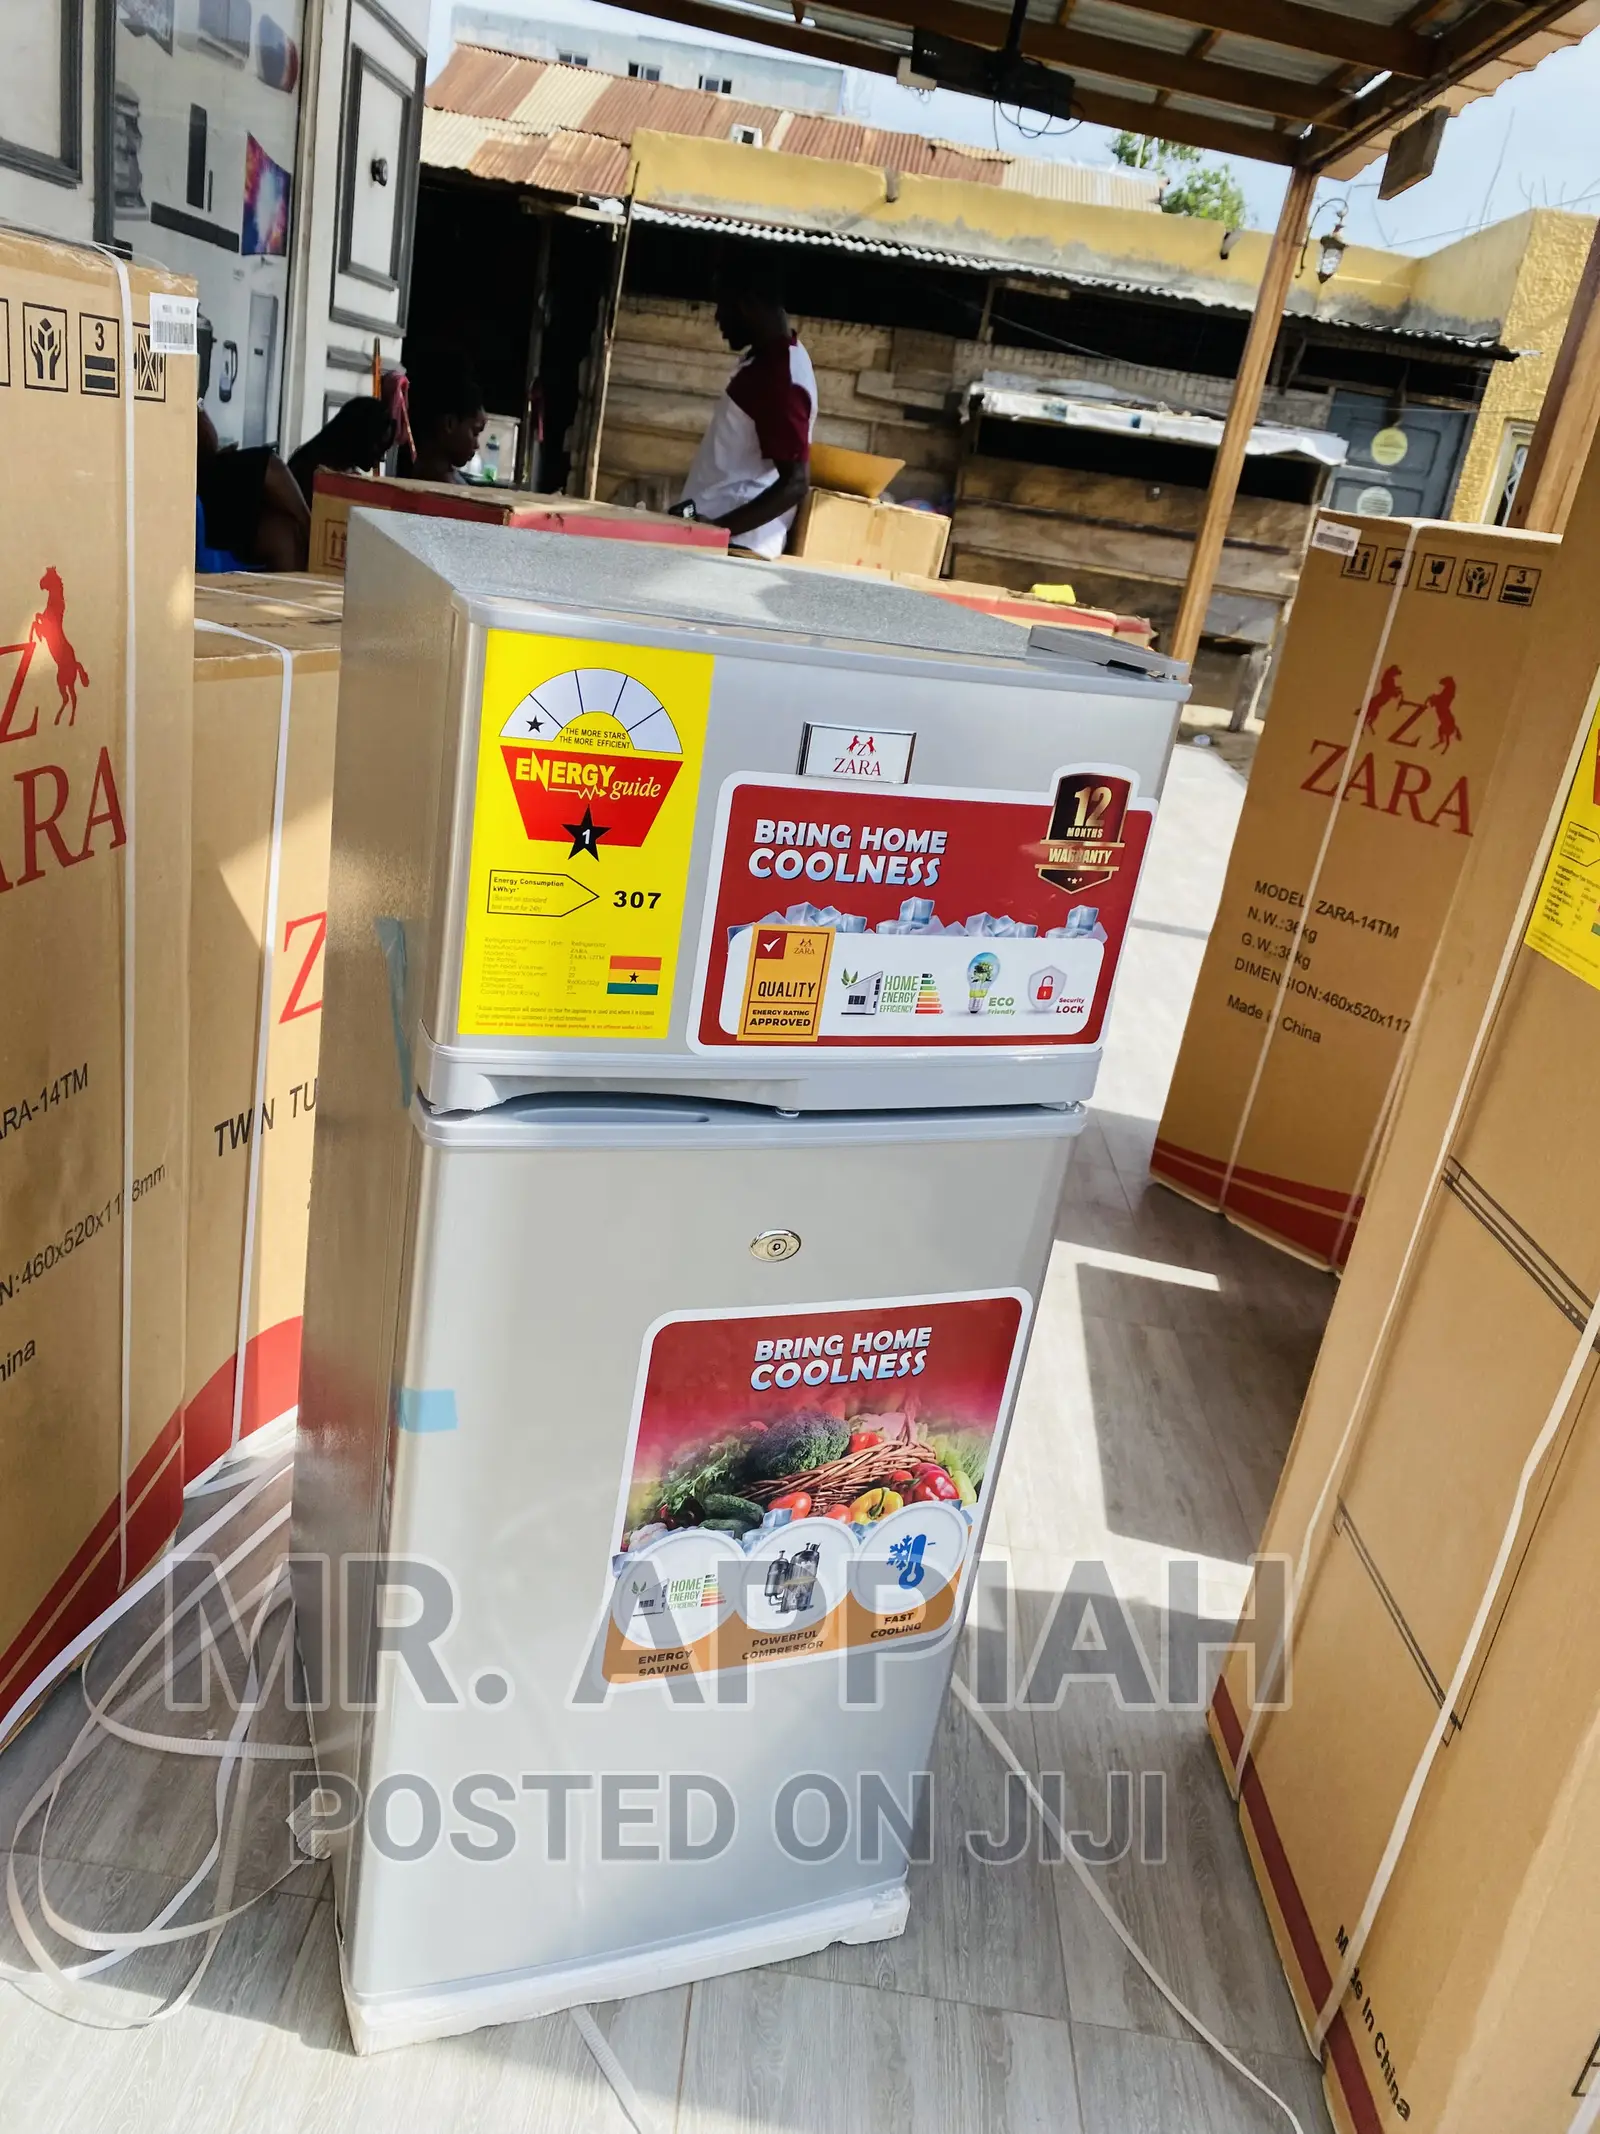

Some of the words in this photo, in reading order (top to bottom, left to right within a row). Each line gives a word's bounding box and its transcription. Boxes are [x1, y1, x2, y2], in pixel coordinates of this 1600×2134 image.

[94, 322, 105, 352] 3
[1516, 570, 1527, 584] 3
[1387, 699, 1428, 748] Z
[559, 735, 573, 744] THE
[574, 737, 594, 746] MORE
[597, 739, 631, 749] EFFICIENT
[566, 727, 579, 736] THE
[581, 729, 602, 738] MORE
[604, 731, 626, 740] STARS
[515, 750, 616, 792] ENERGY
[609, 776, 662, 801] guide
[832, 757, 882, 777] ZARA
[1300, 739, 1473, 838] ZARA
[1073, 786, 1113, 828] 12
[0, 746, 127, 893] RA
[582, 829, 591, 845] 1
[754, 818, 851, 849] BRING
[859, 826, 948, 854] HOME
[1066, 827, 1104, 839] MONTHS
[1048, 848, 1113, 865] WARRANTY
[748, 847, 941, 887] COOLNESS
[493, 876, 517, 886] Energy
[520, 878, 565, 888] Consumption
[612, 890, 662, 909] 307
[1315, 900, 1400, 940] ZARA-14TM
[757, 980, 817, 998] QUALITY
[884, 974, 919, 991] HOME
[881, 992, 917, 1004] ENERGY
[988, 997, 1015, 1007] ECO
[1059, 997, 1085, 1005] Security
[879, 1004, 913, 1013] EFFICIENCY
[987, 1008, 1016, 1016] Friendly
[1056, 1005, 1084, 1014] LOCK
[749, 1018, 811, 1027] APPROVED
[1227, 994, 1263, 1019] Made
[1282, 1016, 1322, 1044] China
[0, 1062, 88, 1141] RA-14TM
[213, 1097, 275, 1158] TWN
[754, 1334, 844, 1362] BRING
[850, 1326, 933, 1355] HOME
[750, 1349, 928, 1391] COOLNESS
[670, 1577, 703, 1593] HOME
[669, 1591, 701, 1603] ENERGY
[884, 1612, 914, 1625] FAST
[752, 1630, 818, 1648] POWERFUL
[870, 1622, 922, 1639] COOLING
[638, 1650, 693, 1665] ENERGY
[741, 1641, 824, 1660] COMPRESSOR
[638, 1662, 689, 1677] SAVING
[1374, 2031, 1411, 2122] China
